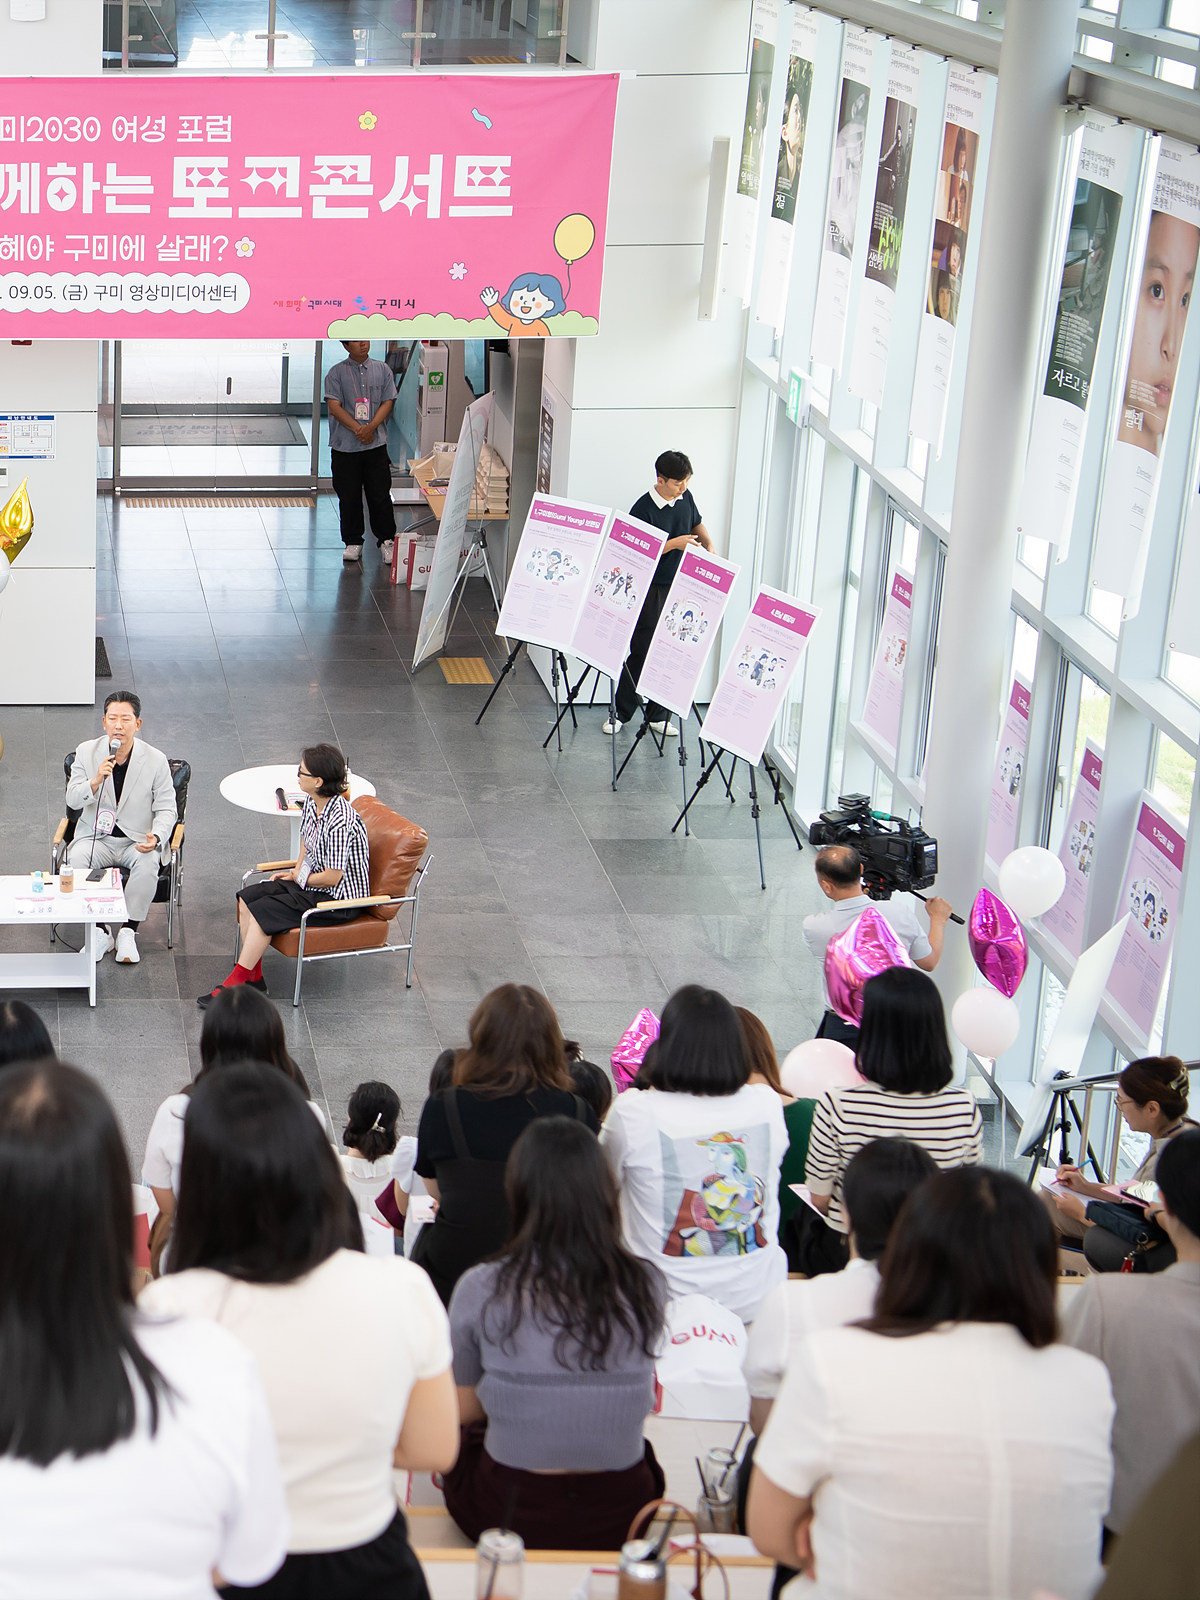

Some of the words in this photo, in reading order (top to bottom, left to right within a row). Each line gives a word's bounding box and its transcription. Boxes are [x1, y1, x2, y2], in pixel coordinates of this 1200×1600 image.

[112, 115, 166, 143] 여성
[176, 115, 232, 143] 포럼
[168, 154, 514, 219] 토크콘서트
[63, 234, 145, 261] 구미에
[156, 234, 229, 262] 살래?
[8, 284, 57, 301] 09.05.
[62, 284, 88, 302] (금)
[94, 284, 123, 302] 구미
[129, 284, 238, 302] 영상미디어센터
[375, 298, 416, 309] 구미시
[1052, 368, 1080, 393] 자르고
[671, 1323, 739, 1347] GUMI
